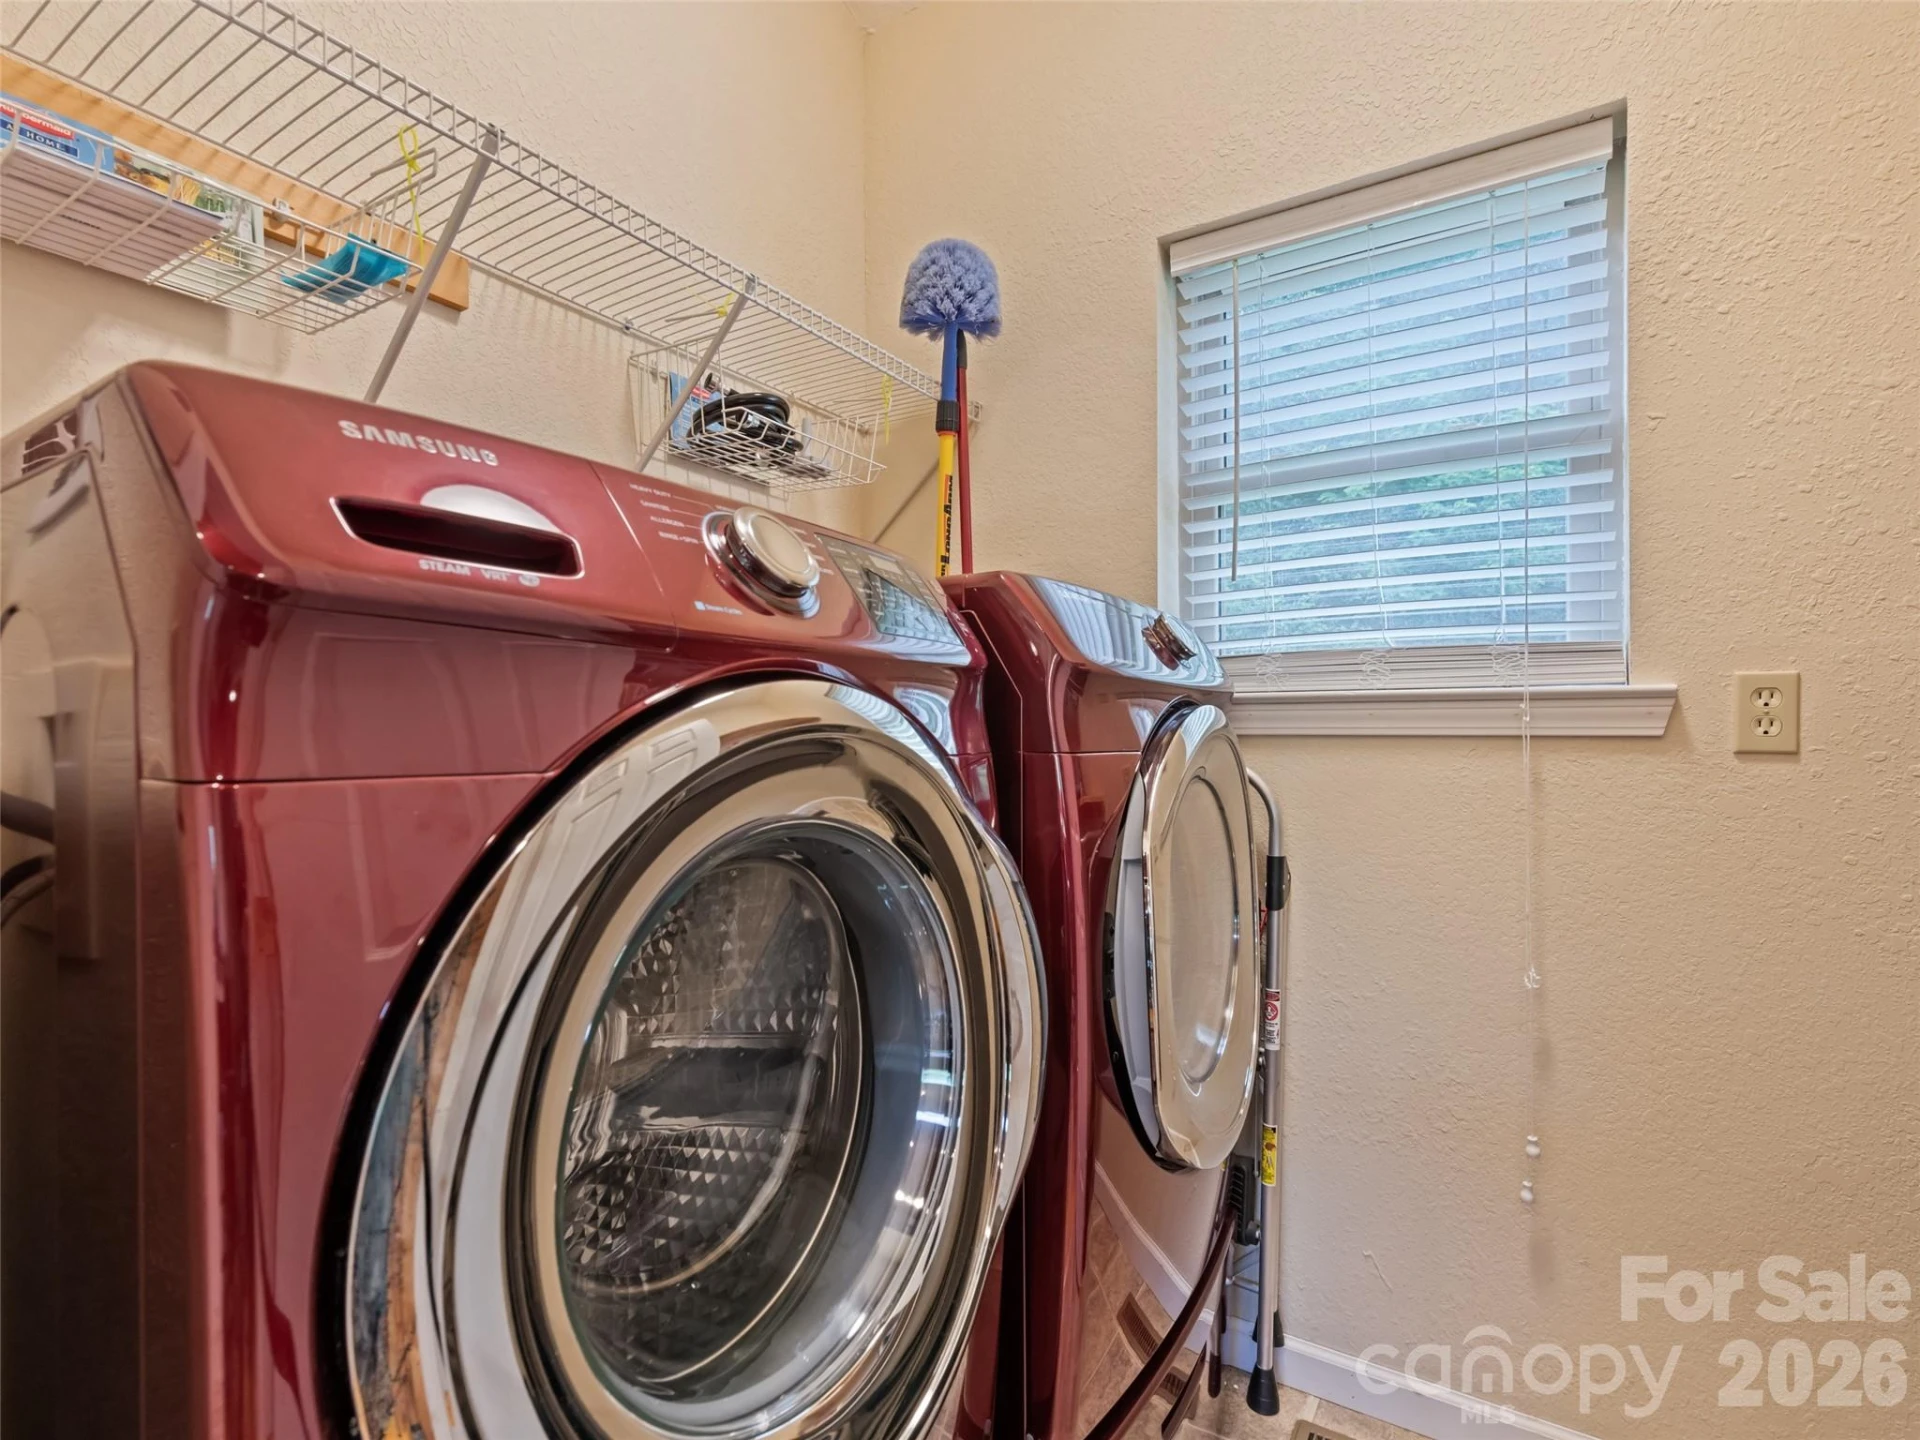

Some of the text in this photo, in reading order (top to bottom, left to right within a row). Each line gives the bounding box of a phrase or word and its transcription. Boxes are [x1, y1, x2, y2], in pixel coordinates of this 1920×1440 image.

[26, 130, 66, 152] HOME
[338, 420, 499, 466] SAMSUNG
[419, 559, 471, 577] STEAM
